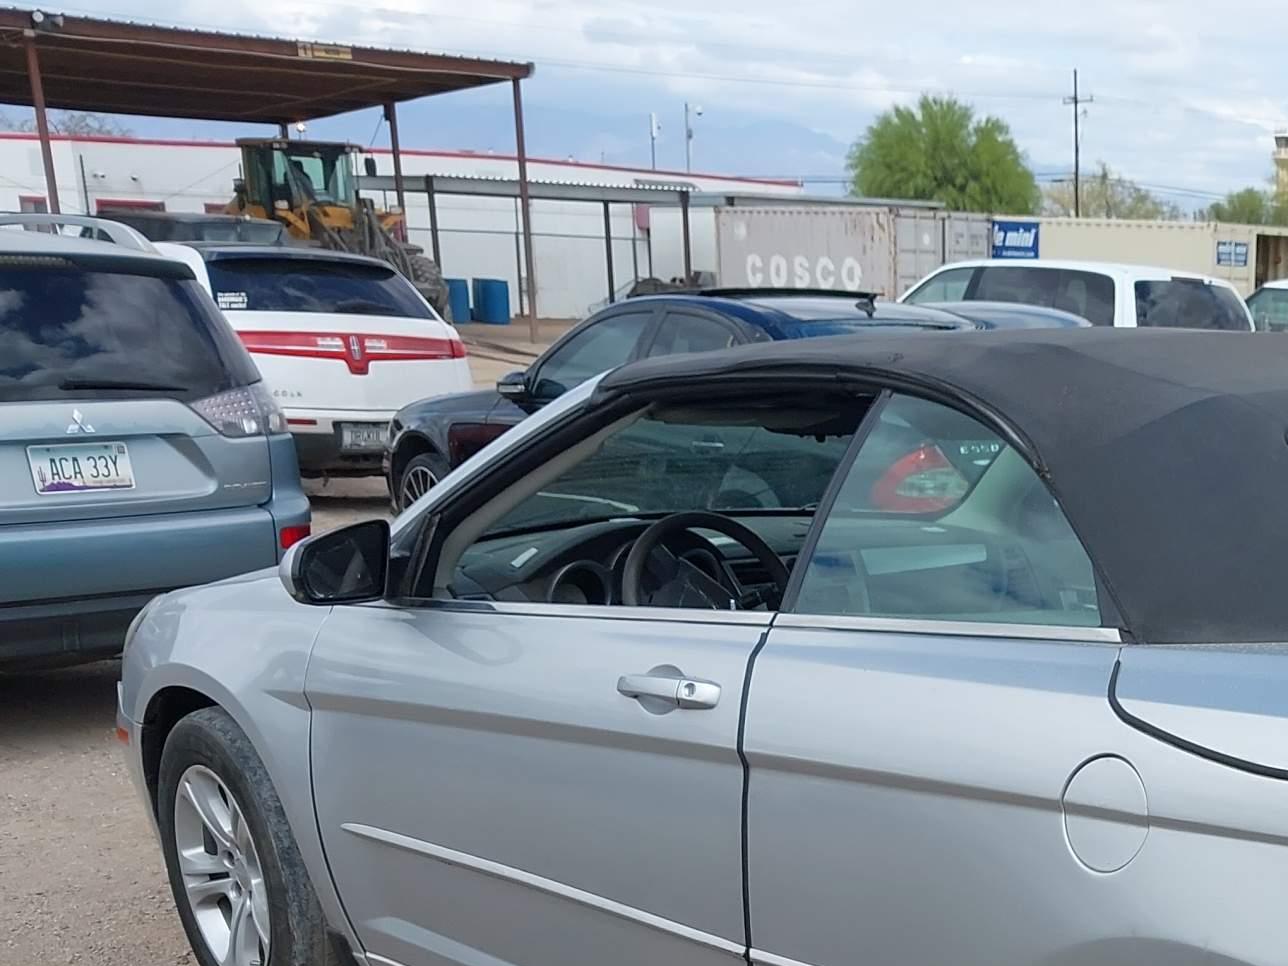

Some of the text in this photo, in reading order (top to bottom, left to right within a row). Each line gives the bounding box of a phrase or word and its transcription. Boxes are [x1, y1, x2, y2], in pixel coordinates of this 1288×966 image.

[746, 253, 863, 292] COSCO
[48, 454, 119, 481] ACA 33Y
